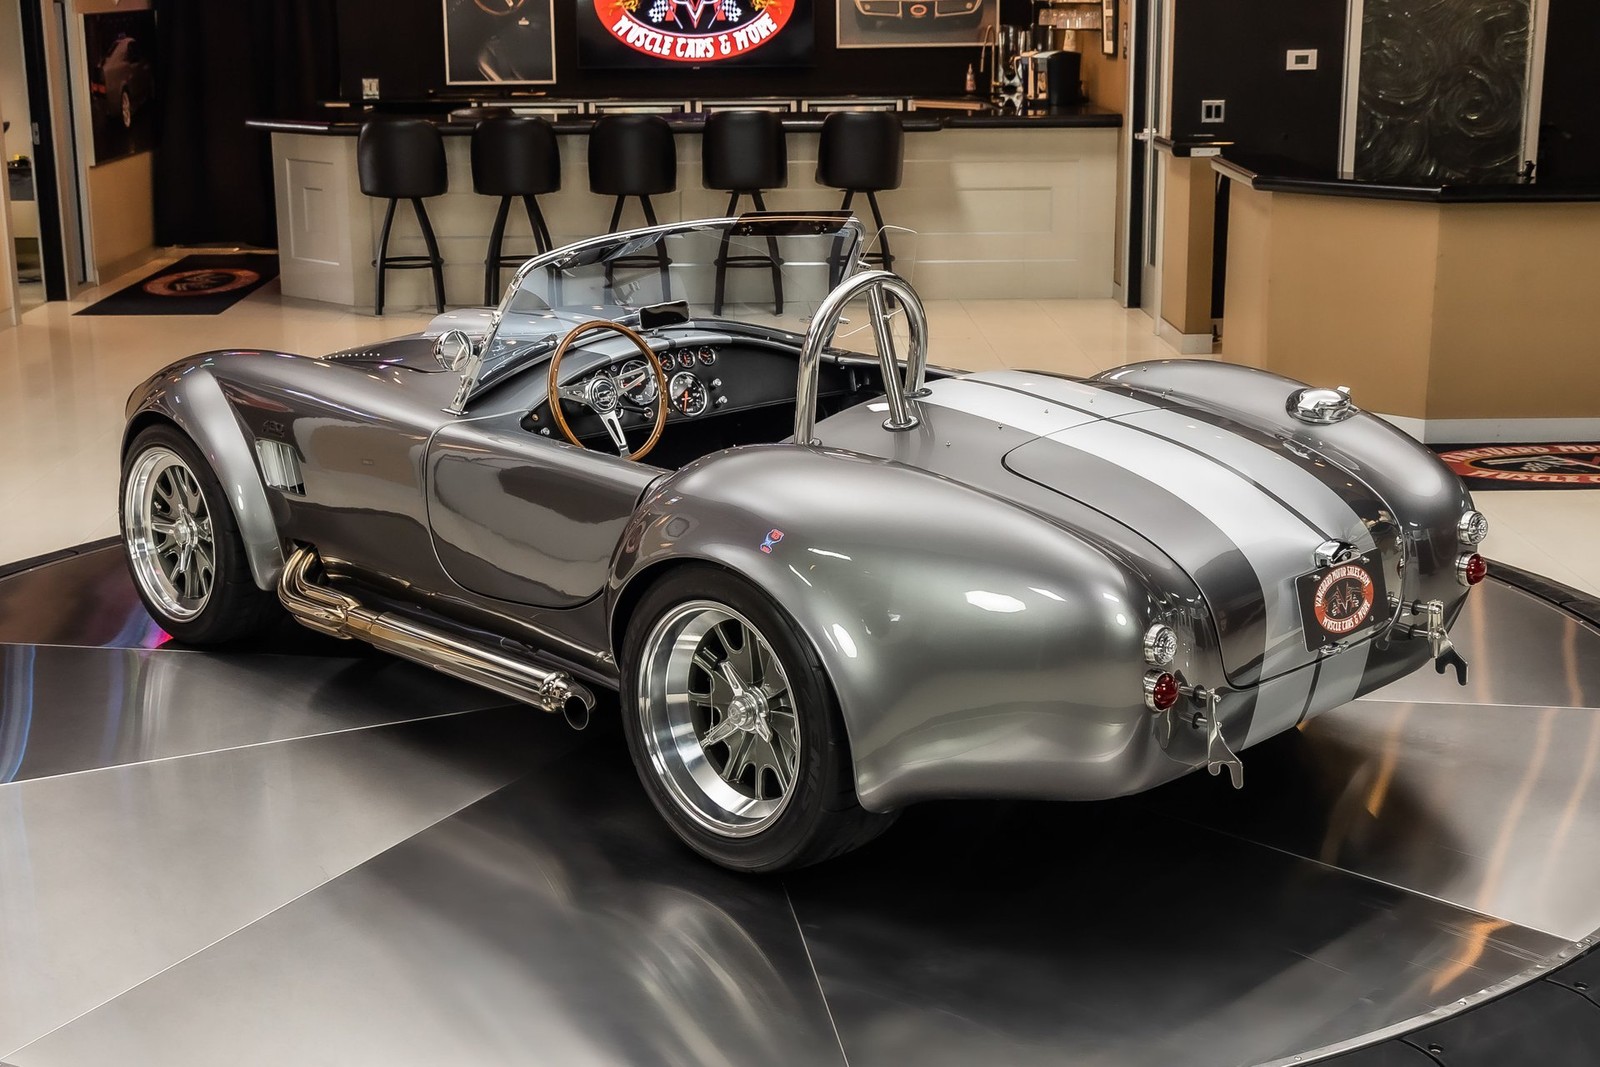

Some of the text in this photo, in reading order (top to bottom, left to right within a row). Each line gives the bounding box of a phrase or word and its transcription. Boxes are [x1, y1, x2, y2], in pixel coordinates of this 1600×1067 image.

[612, 13, 778, 58] MUSCLE CARS & MORE
[1466, 470, 1580, 482] MUSCLE
[1331, 567, 1347, 581] MOTOR
[1322, 616, 1342, 631] MUSCLE
